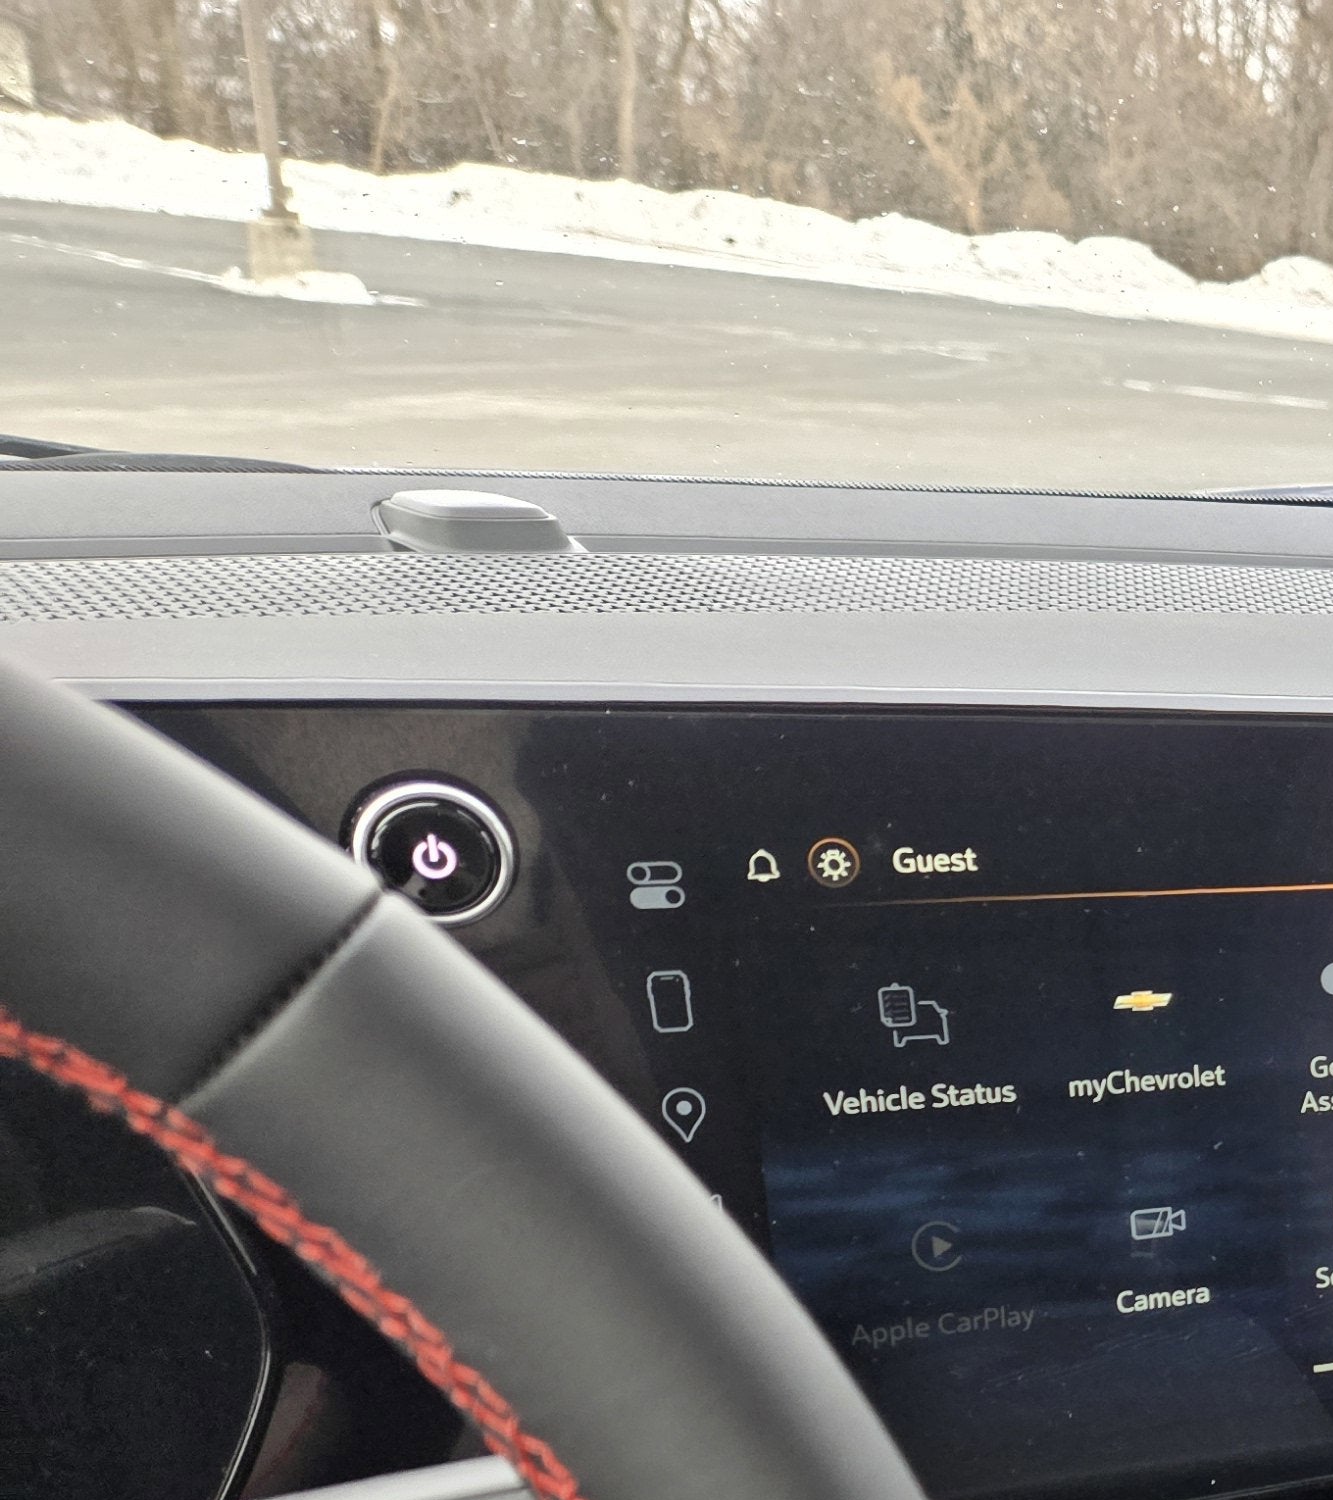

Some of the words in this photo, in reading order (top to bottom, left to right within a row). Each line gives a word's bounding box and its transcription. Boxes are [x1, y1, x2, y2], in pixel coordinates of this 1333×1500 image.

[892, 847, 978, 874] Guest
[822, 1086, 925, 1116] Vehicle
[931, 1081, 1017, 1110] Status
[1067, 1064, 1226, 1101] myChevrolet
[1115, 1284, 1211, 1314] Camera
[851, 1316, 931, 1348] Apple
[937, 1305, 1036, 1337] CarPlay
